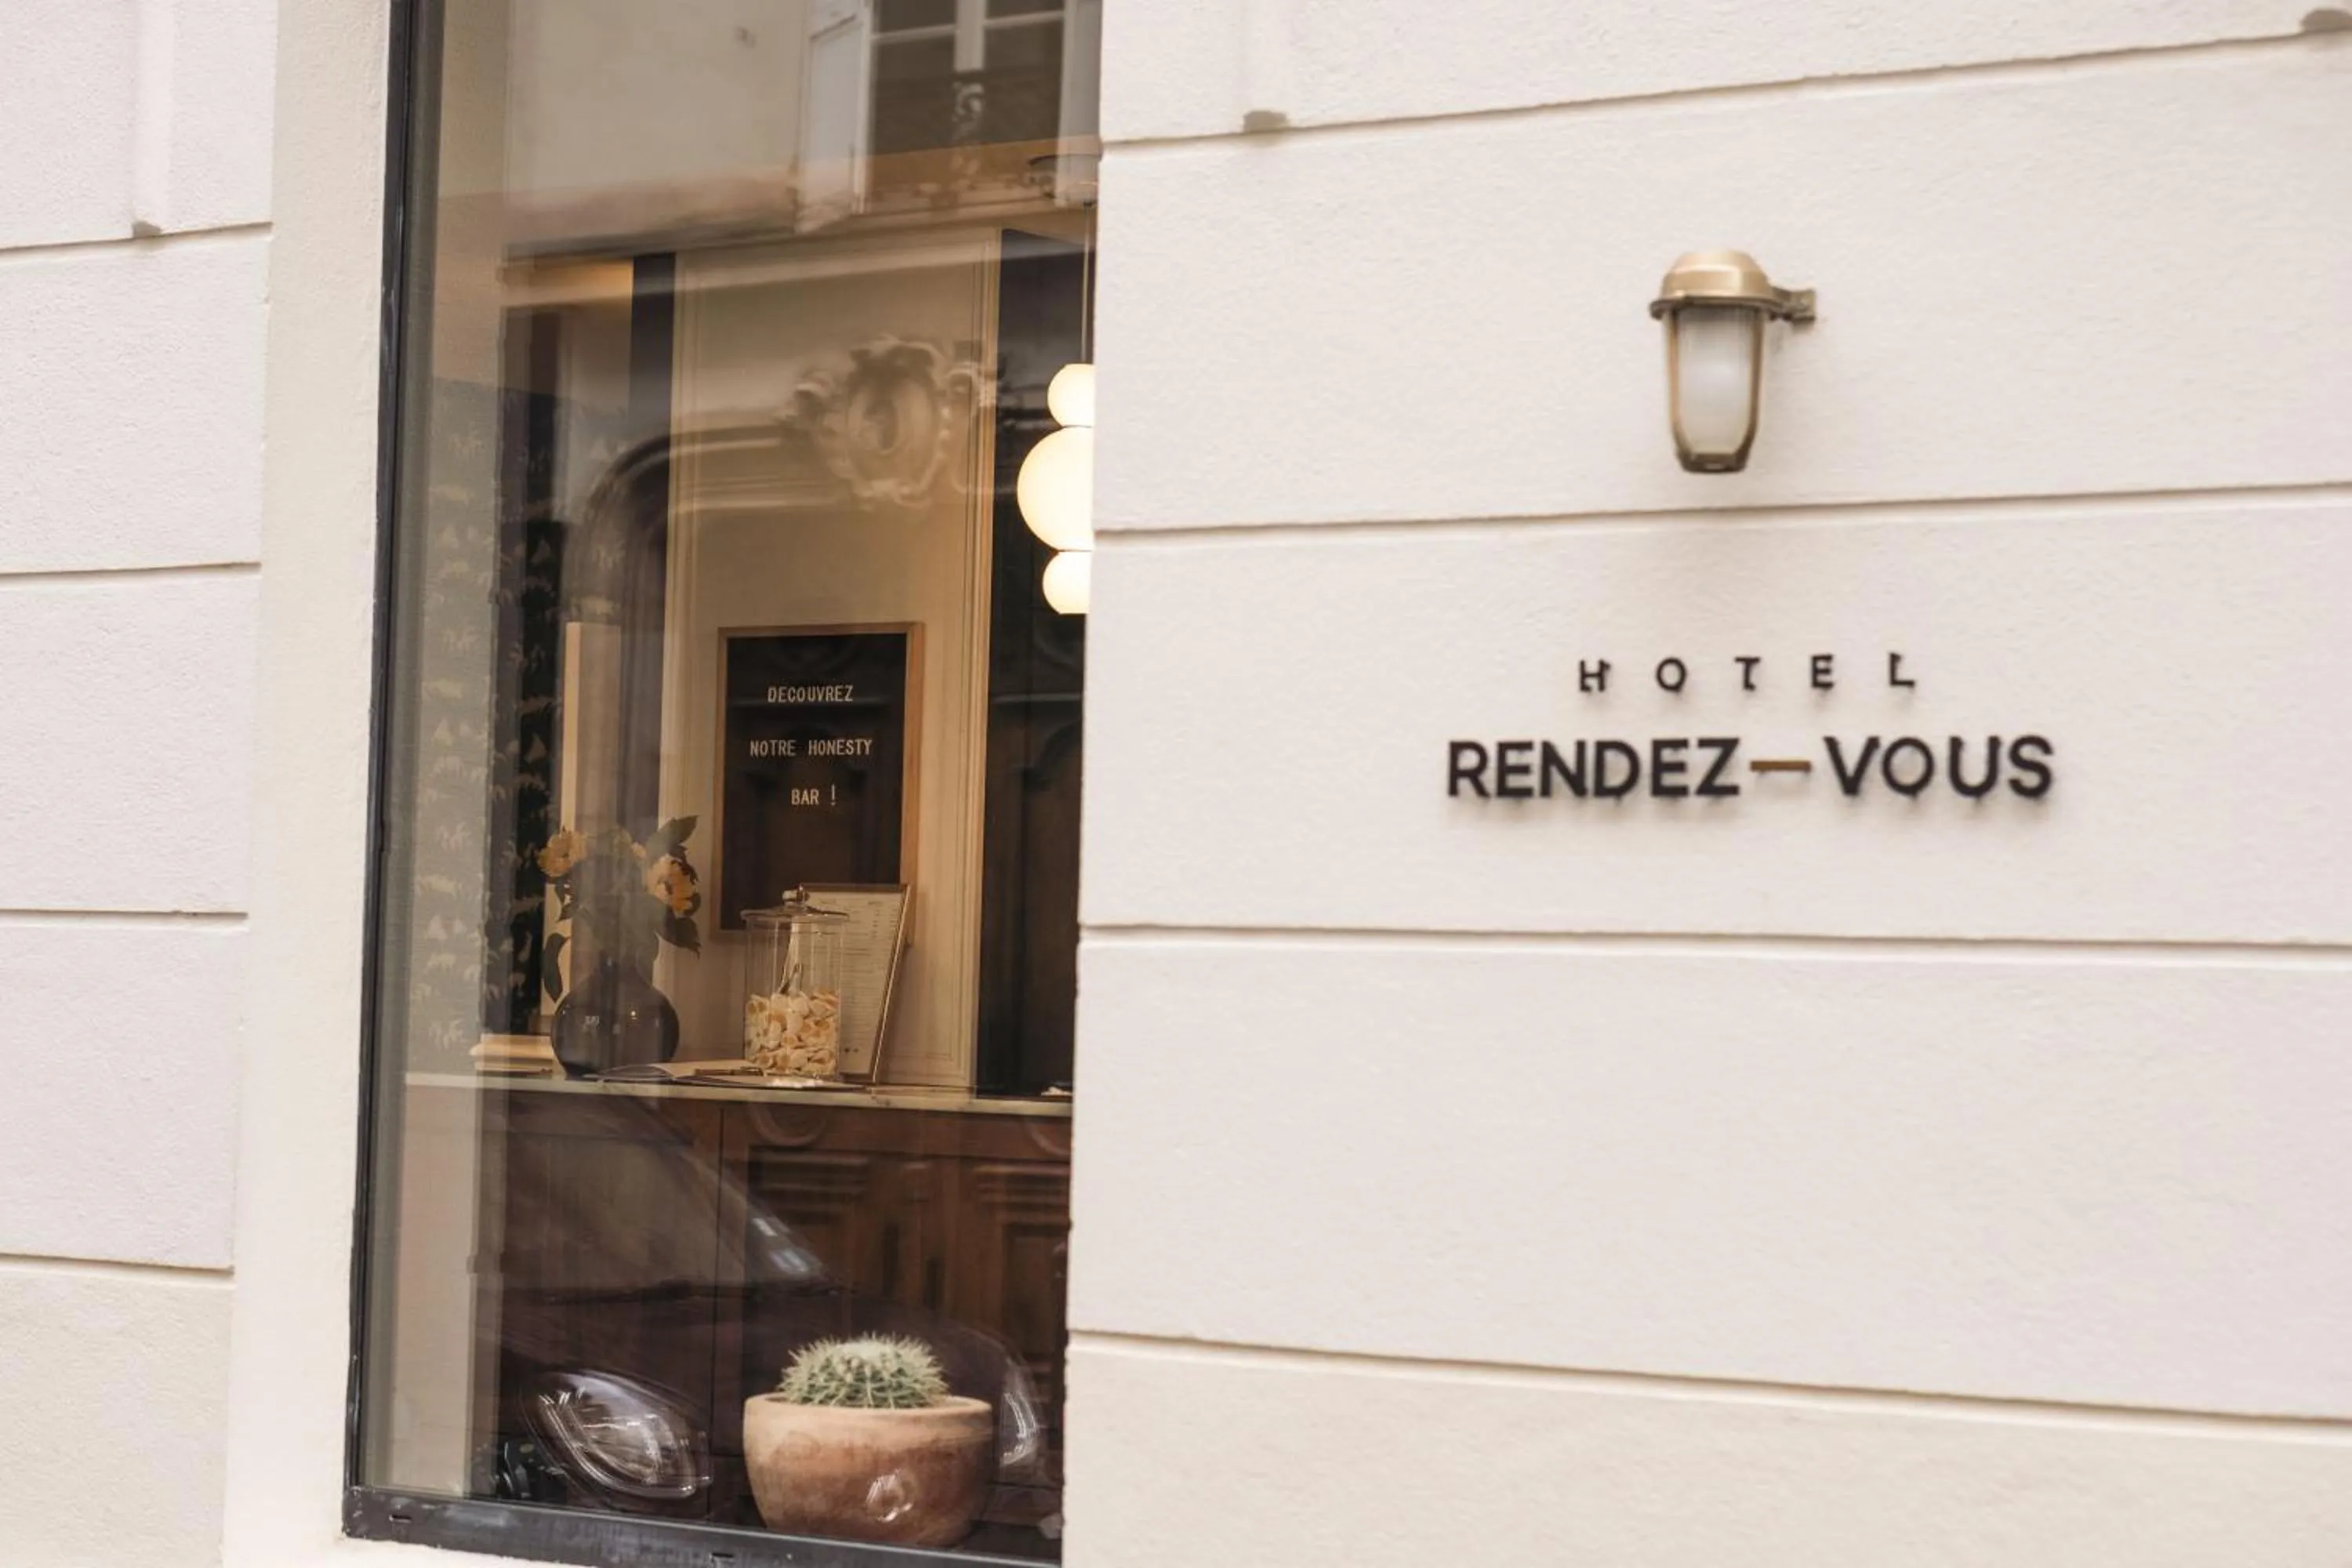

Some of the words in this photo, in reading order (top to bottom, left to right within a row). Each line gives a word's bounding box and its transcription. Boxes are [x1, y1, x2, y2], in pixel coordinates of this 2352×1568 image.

[1578, 652, 1915, 693] HOTEL
[768, 685, 854, 702] DECOUVREZ
[750, 739, 797, 756] NOTRE
[808, 739, 873, 756] HONESTY
[791, 788, 819, 805] BAR
